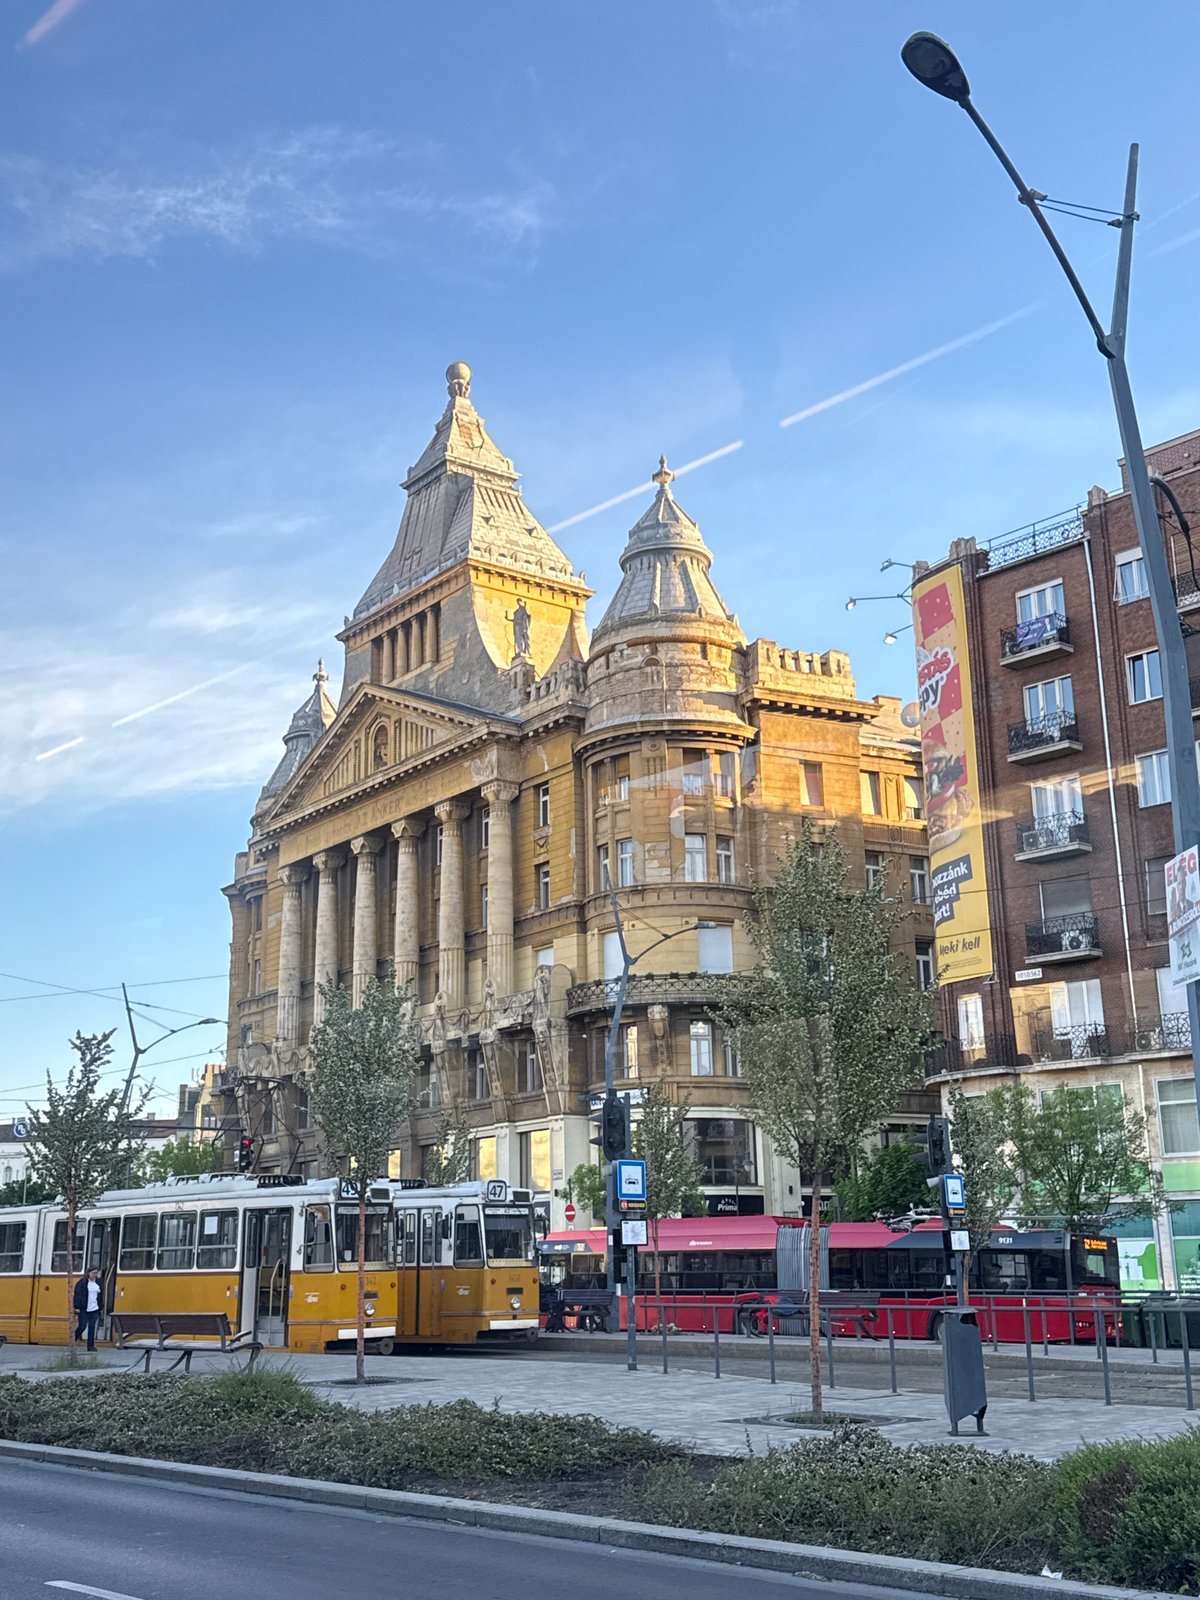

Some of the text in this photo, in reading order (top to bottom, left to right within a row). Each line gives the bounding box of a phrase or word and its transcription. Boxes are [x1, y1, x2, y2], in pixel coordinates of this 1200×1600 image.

[962, 935, 981, 951] kell
[342, 1182, 359, 1196] 49
[489, 1185, 504, 1198] 47
